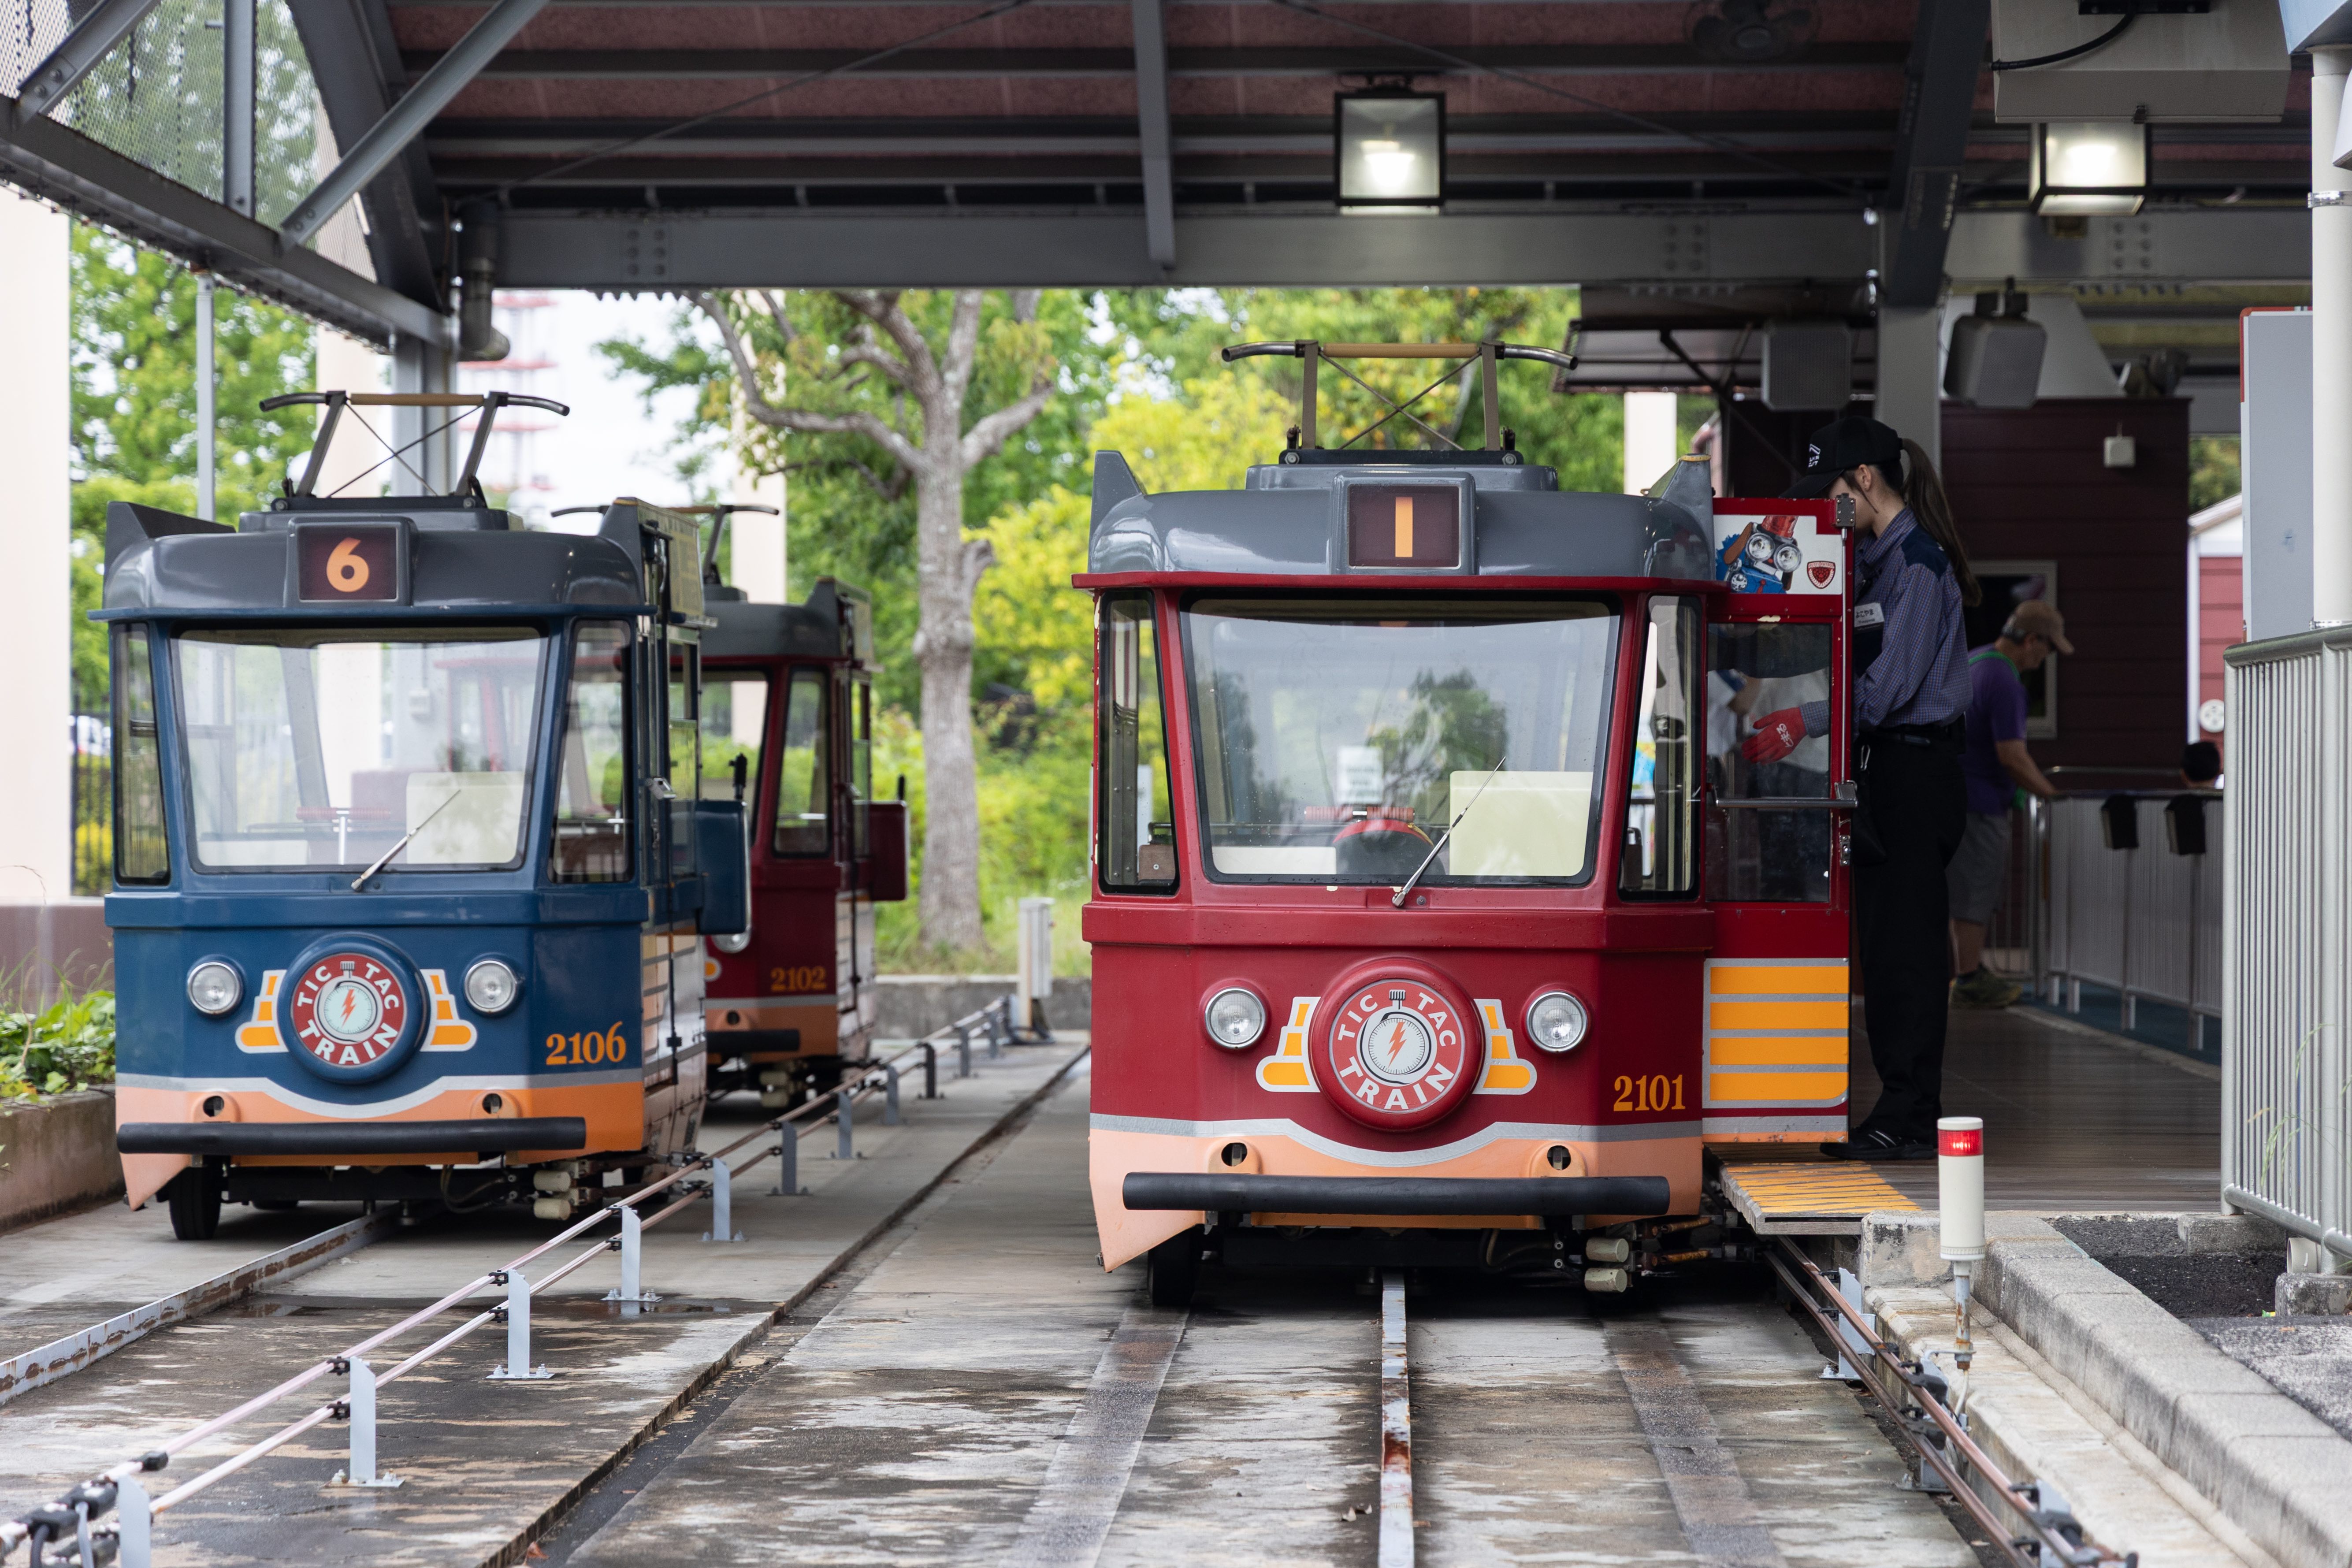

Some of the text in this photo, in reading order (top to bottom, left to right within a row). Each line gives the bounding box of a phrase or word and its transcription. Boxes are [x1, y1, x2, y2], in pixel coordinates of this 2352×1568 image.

[1395, 497, 1413, 557] 1
[327, 537, 369, 593] 6
[1856, 609, 1874, 618] よこやま
[1776, 723, 1794, 747] とまる
[297, 962, 399, 1010] TIC TAC
[771, 966, 827, 991] 2102
[299, 1019, 398, 1064] TRAIN
[1338, 992, 1456, 1047] TIC TAC
[546, 1021, 626, 1065] 2106
[1339, 1056, 1455, 1110] TRAIN
[1613, 1074, 1686, 1111] 2101
